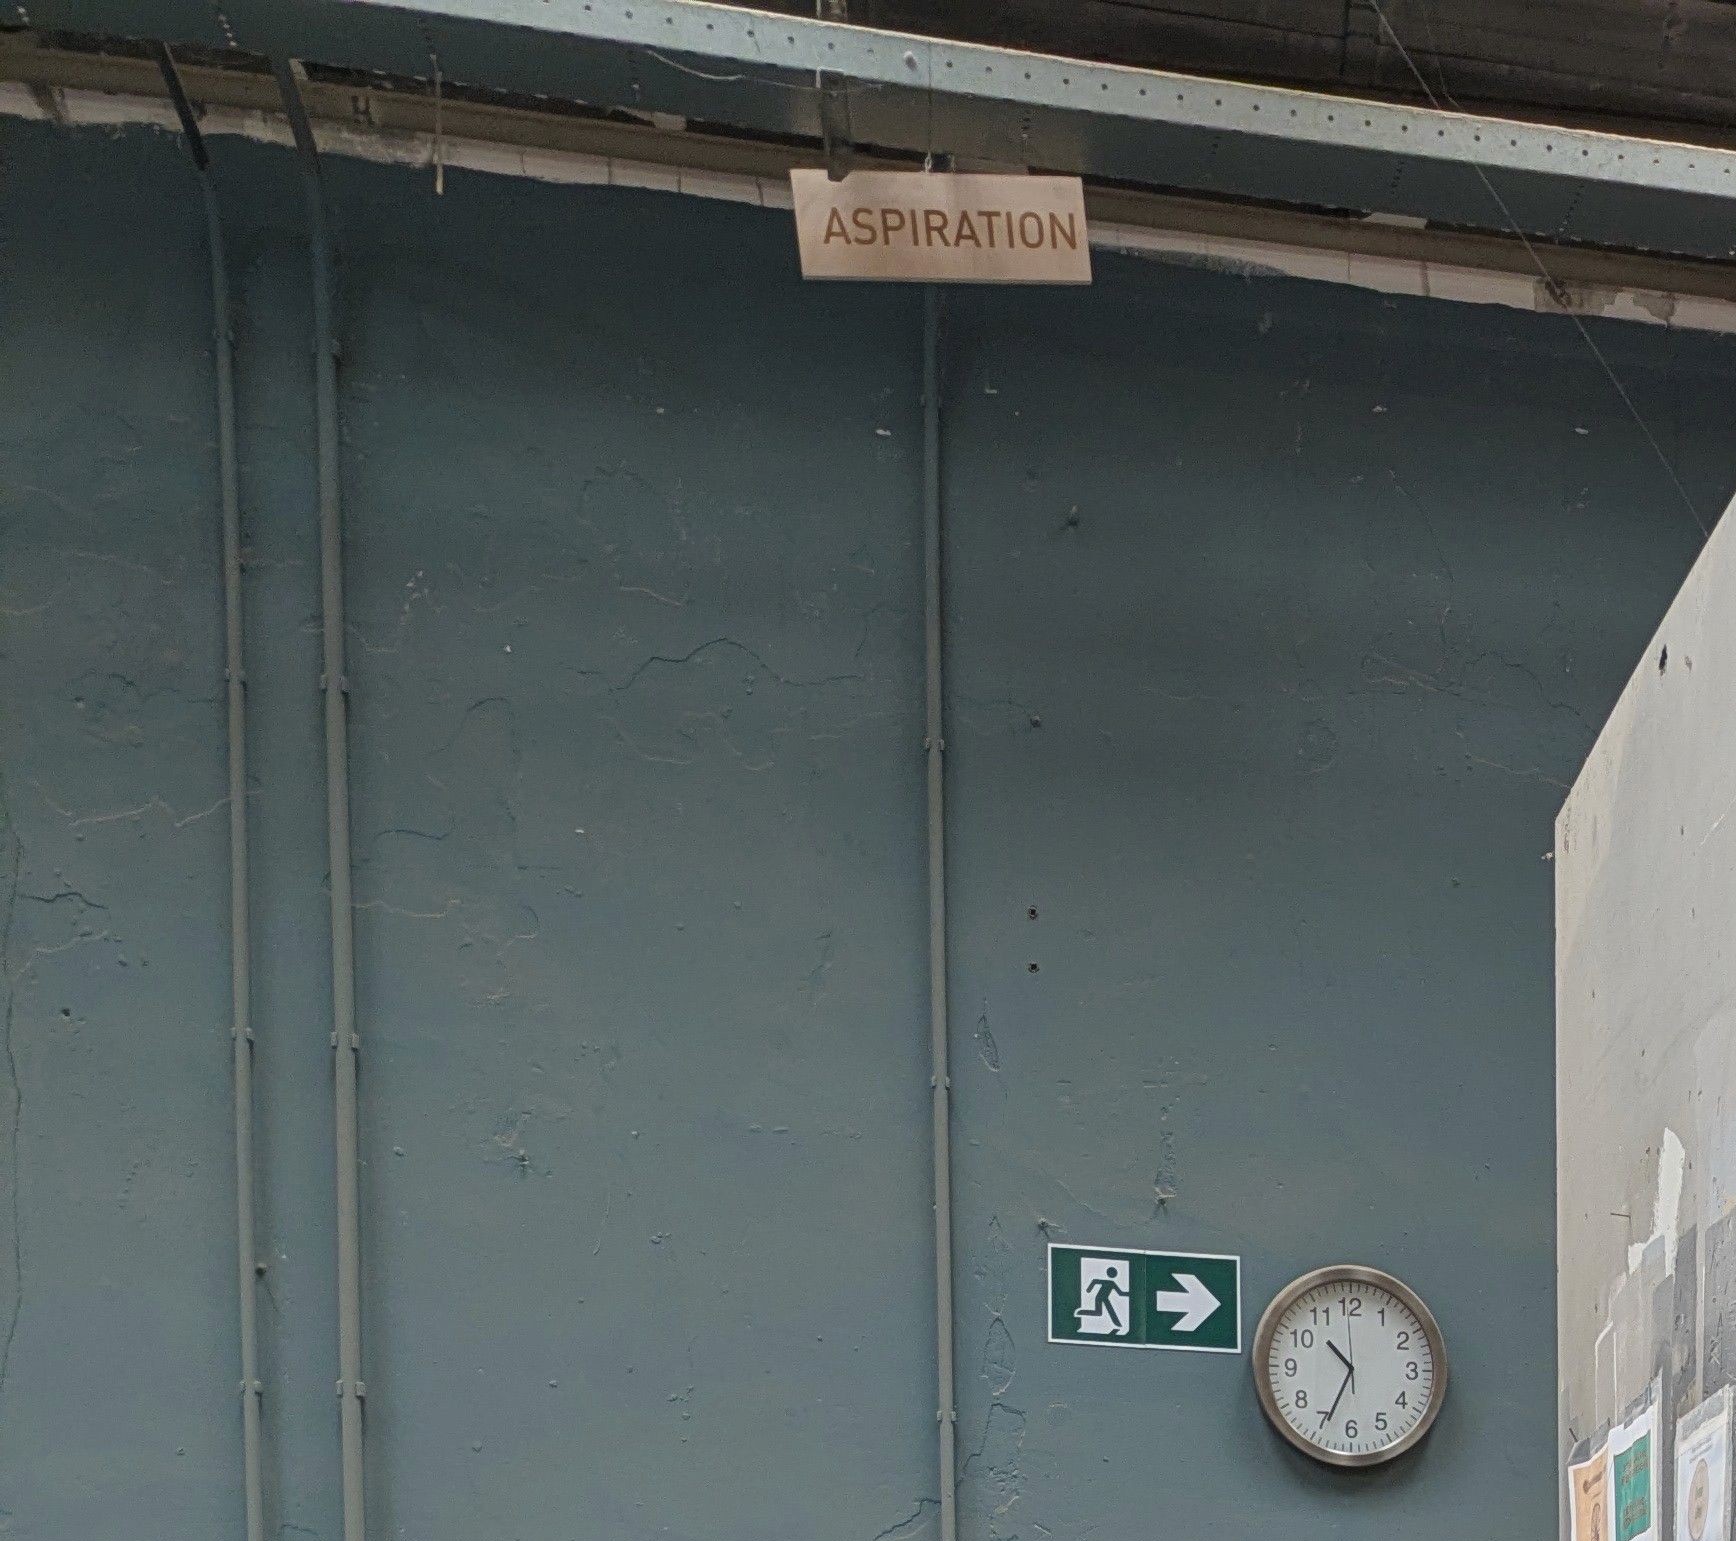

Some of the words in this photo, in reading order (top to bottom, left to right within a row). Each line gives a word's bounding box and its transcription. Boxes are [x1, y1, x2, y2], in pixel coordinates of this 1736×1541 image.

[823, 207, 1077, 250] ASPIRATION
[1309, 1306, 1331, 1326] 11
[1338, 1297, 1362, 1317] 12
[1377, 1307, 1386, 1327] 1
[1290, 1328, 1314, 1349] 10
[1396, 1331, 1410, 1351] 2
[1284, 1358, 1298, 1377] 9
[1405, 1361, 1419, 1381] 3
[1294, 1390, 1308, 1409] 8
[1394, 1390, 1408, 1409] 4
[1316, 1411, 1329, 1429] 7
[1345, 1419, 1358, 1439] 6
[1375, 1412, 1388, 1431] 5
